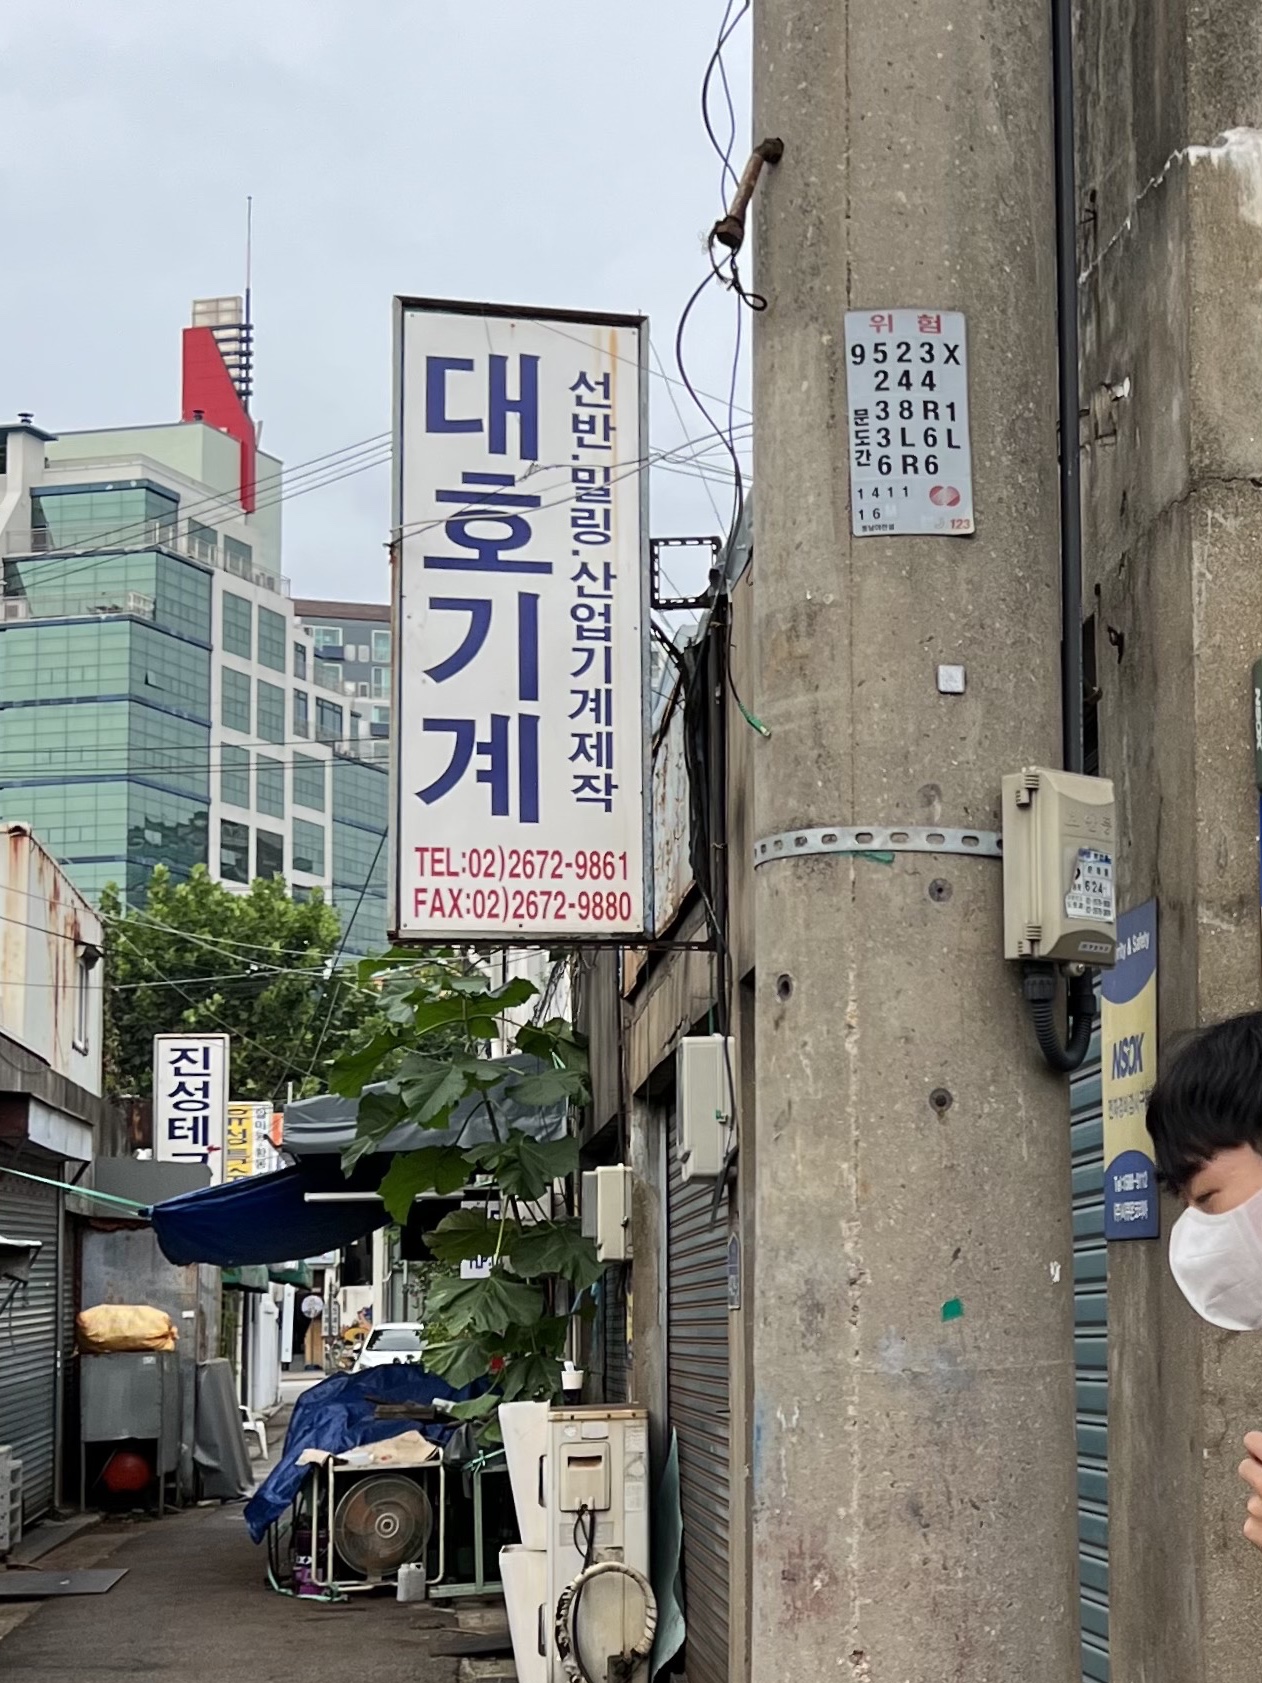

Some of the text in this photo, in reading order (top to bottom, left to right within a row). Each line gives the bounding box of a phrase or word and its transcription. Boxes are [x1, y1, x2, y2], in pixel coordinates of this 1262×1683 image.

[850, 341, 961, 366] 9523X
[873, 369, 937, 392] 244
[877, 454, 939, 476] 6R6
[414, 353, 554, 825] 대호기계
[414, 845, 629, 883] TEL:02)2672-9861
[412, 886, 633, 923] FAX:02)2672-9880
